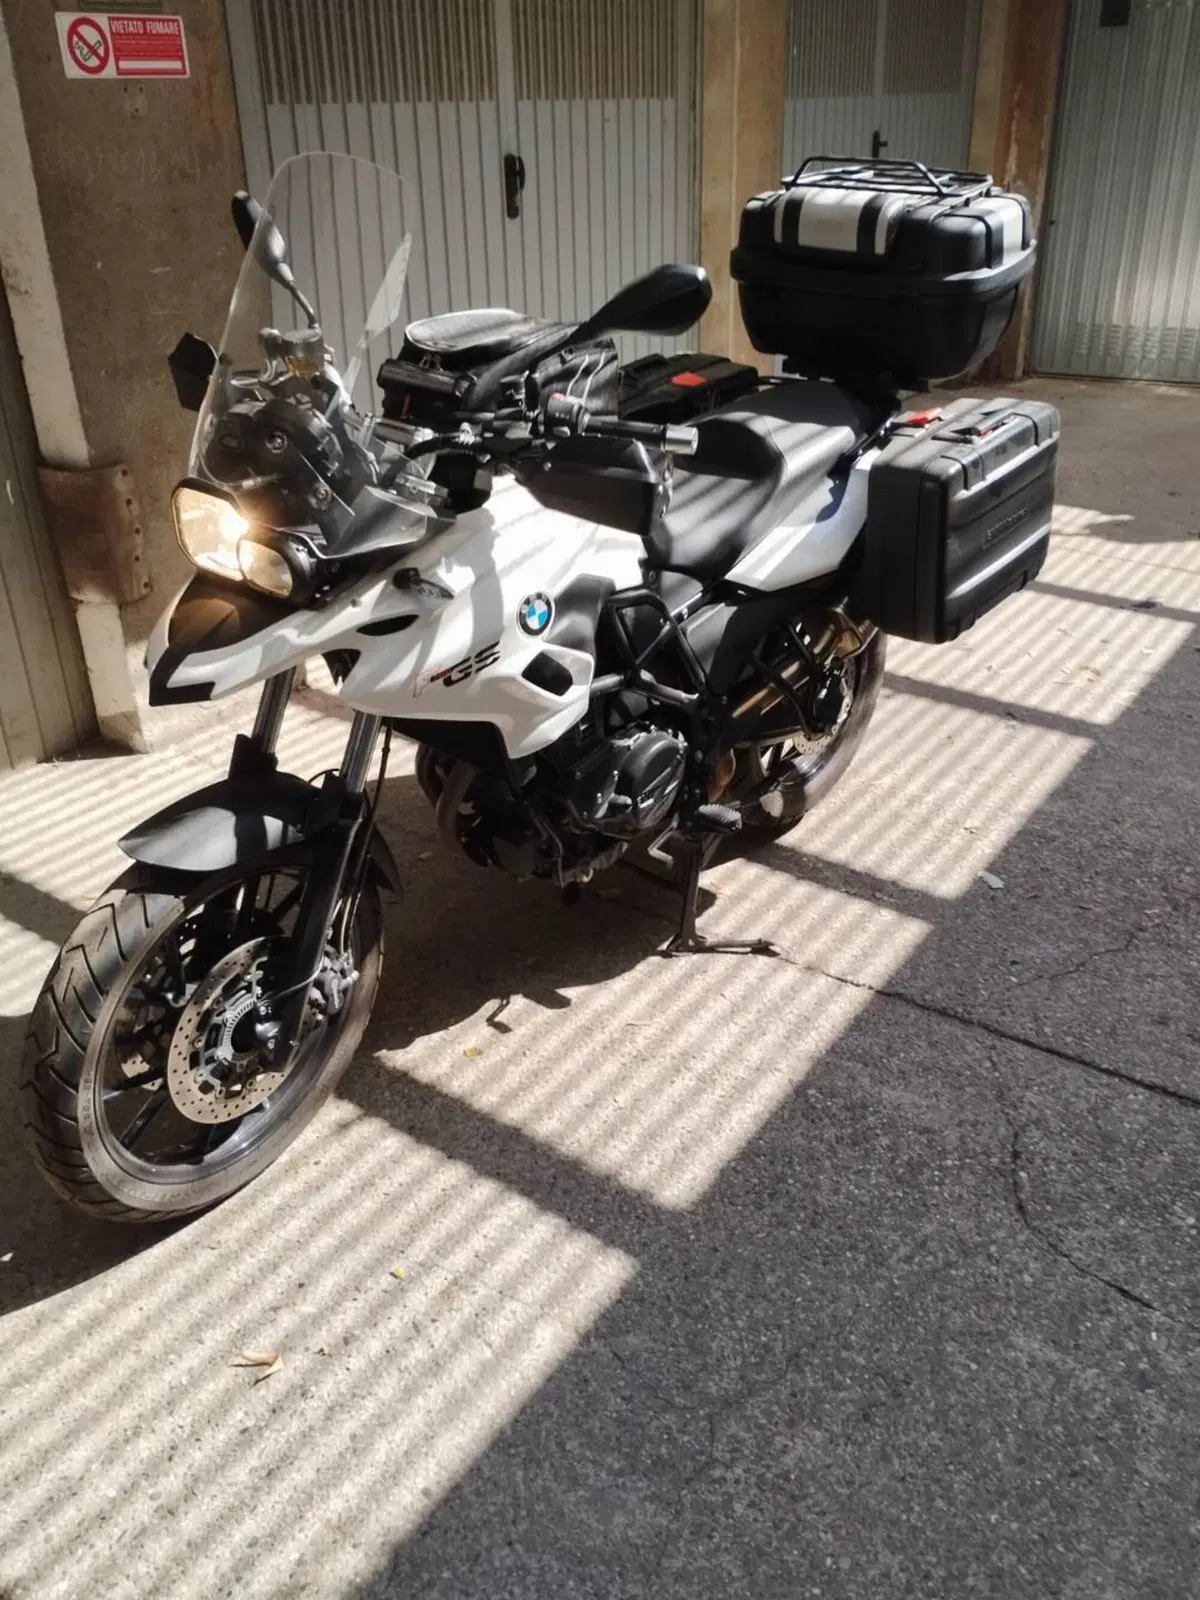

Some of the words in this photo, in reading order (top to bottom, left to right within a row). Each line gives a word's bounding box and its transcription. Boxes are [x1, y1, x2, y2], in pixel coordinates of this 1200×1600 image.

[110, 19, 144, 34] VIETATO
[145, 20, 180, 35] FUMARE
[442, 640, 500, 688] GS
